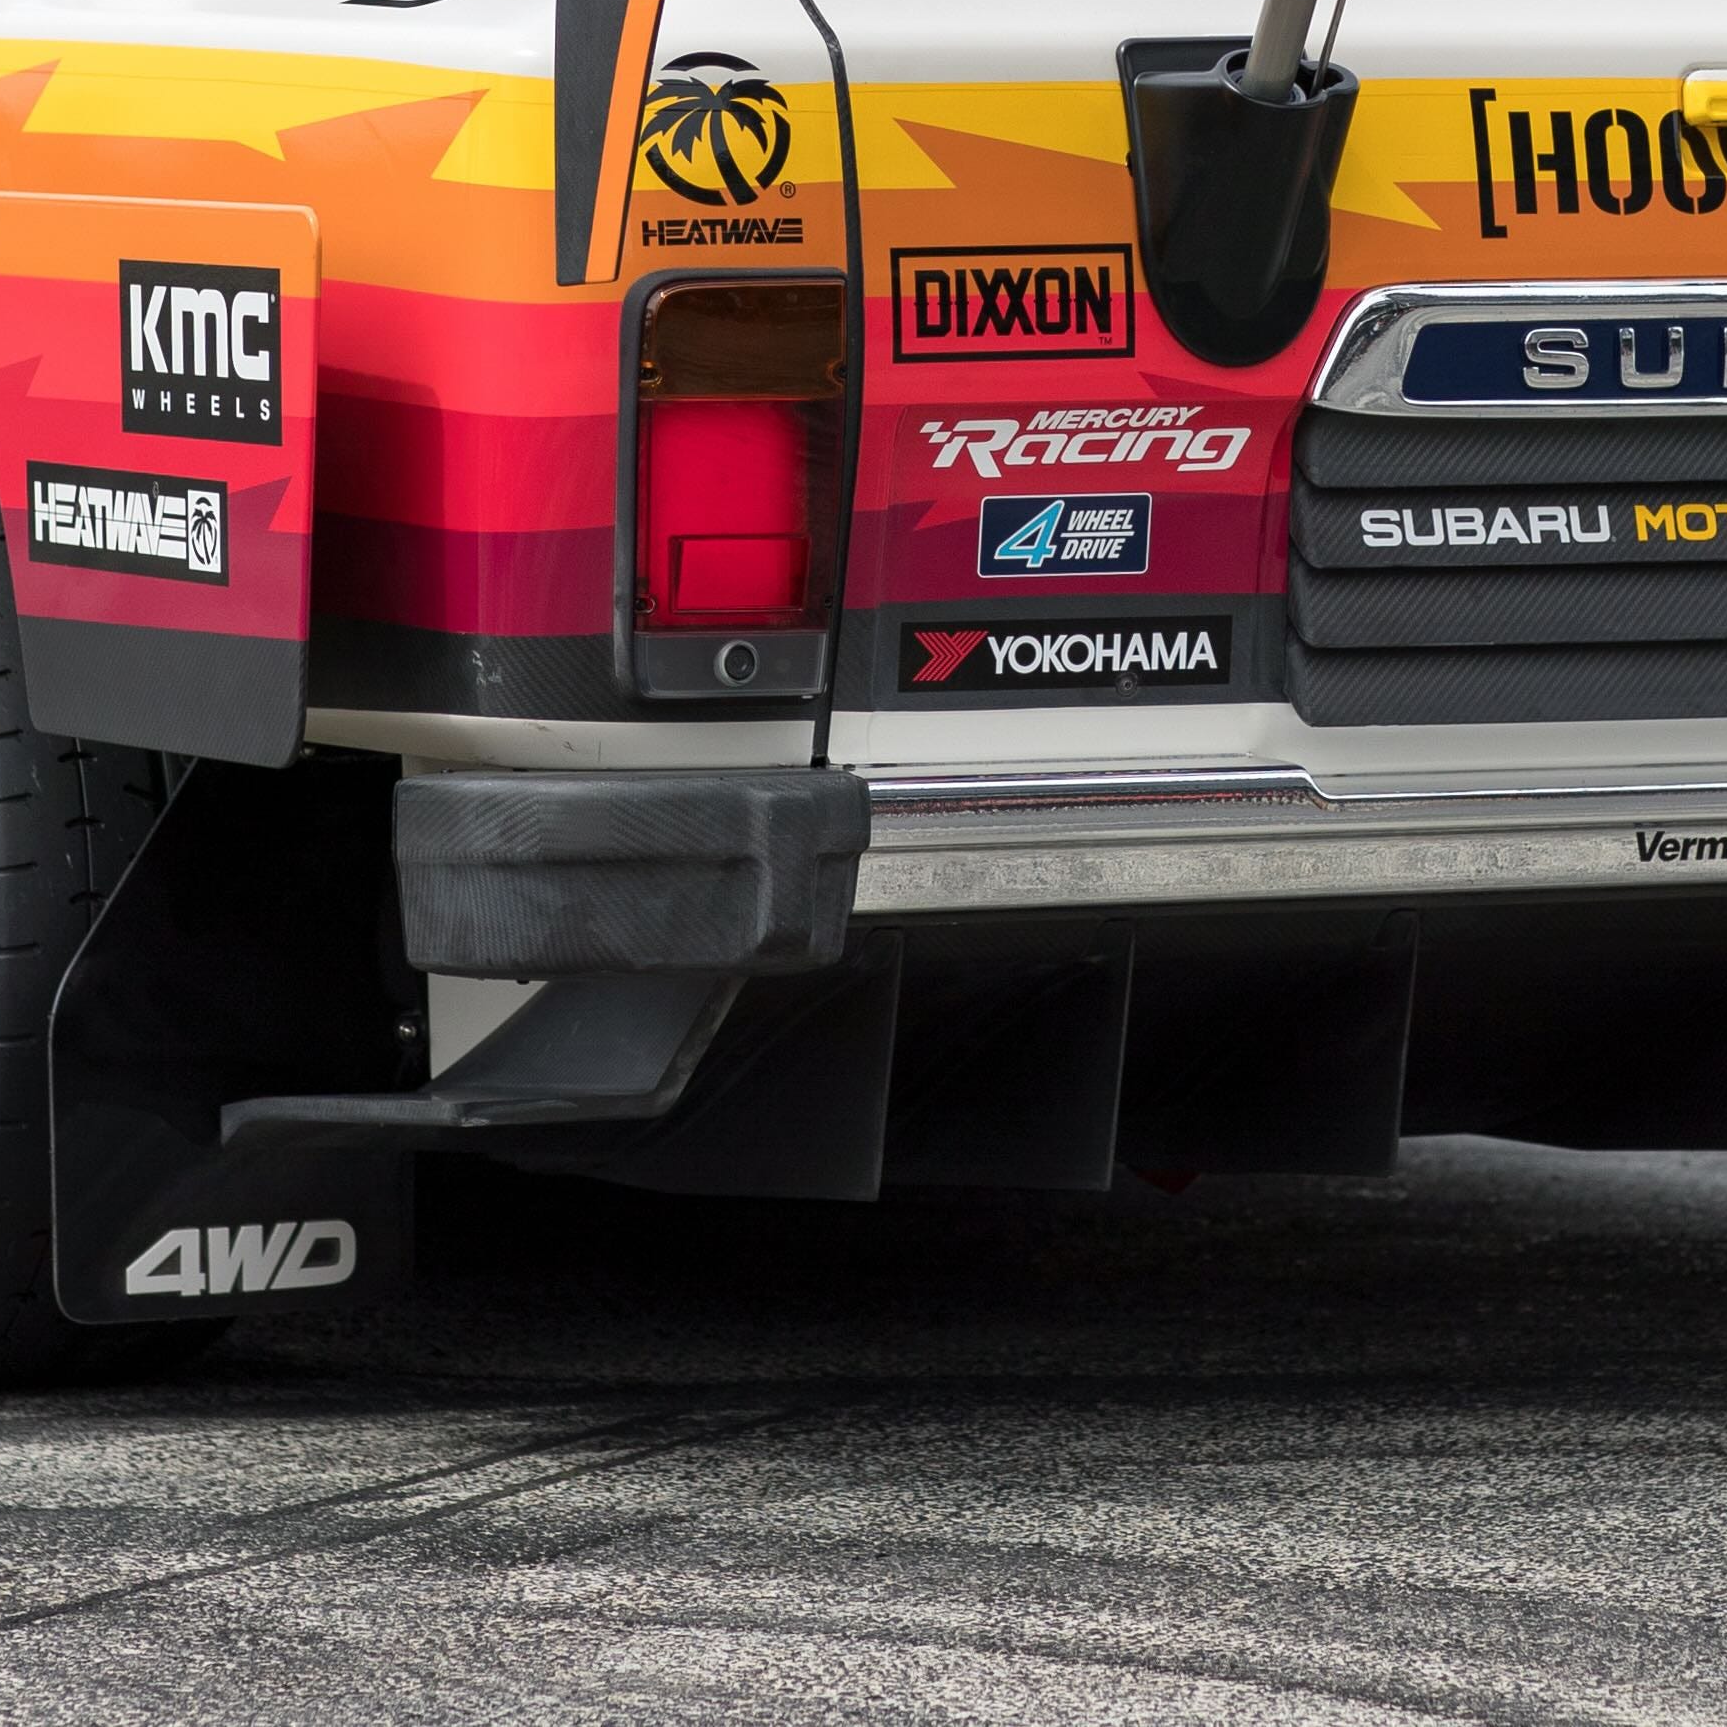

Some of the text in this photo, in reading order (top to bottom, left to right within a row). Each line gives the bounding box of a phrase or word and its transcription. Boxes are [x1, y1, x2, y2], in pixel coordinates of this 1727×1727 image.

[913, 265, 1113, 338] DIXXON
[131, 387, 272, 423] WHEELS
[1025, 405, 1205, 432] MERCURY
[923, 419, 1252, 479] Racing
[993, 499, 1135, 570] 4 WHEEL
[1360, 504, 1612, 548] SUBARU
[1060, 536, 1127, 562] DRIVE
[986, 630, 1219, 674] YOKOHAMA
[125, 1218, 358, 1298] 4WD
